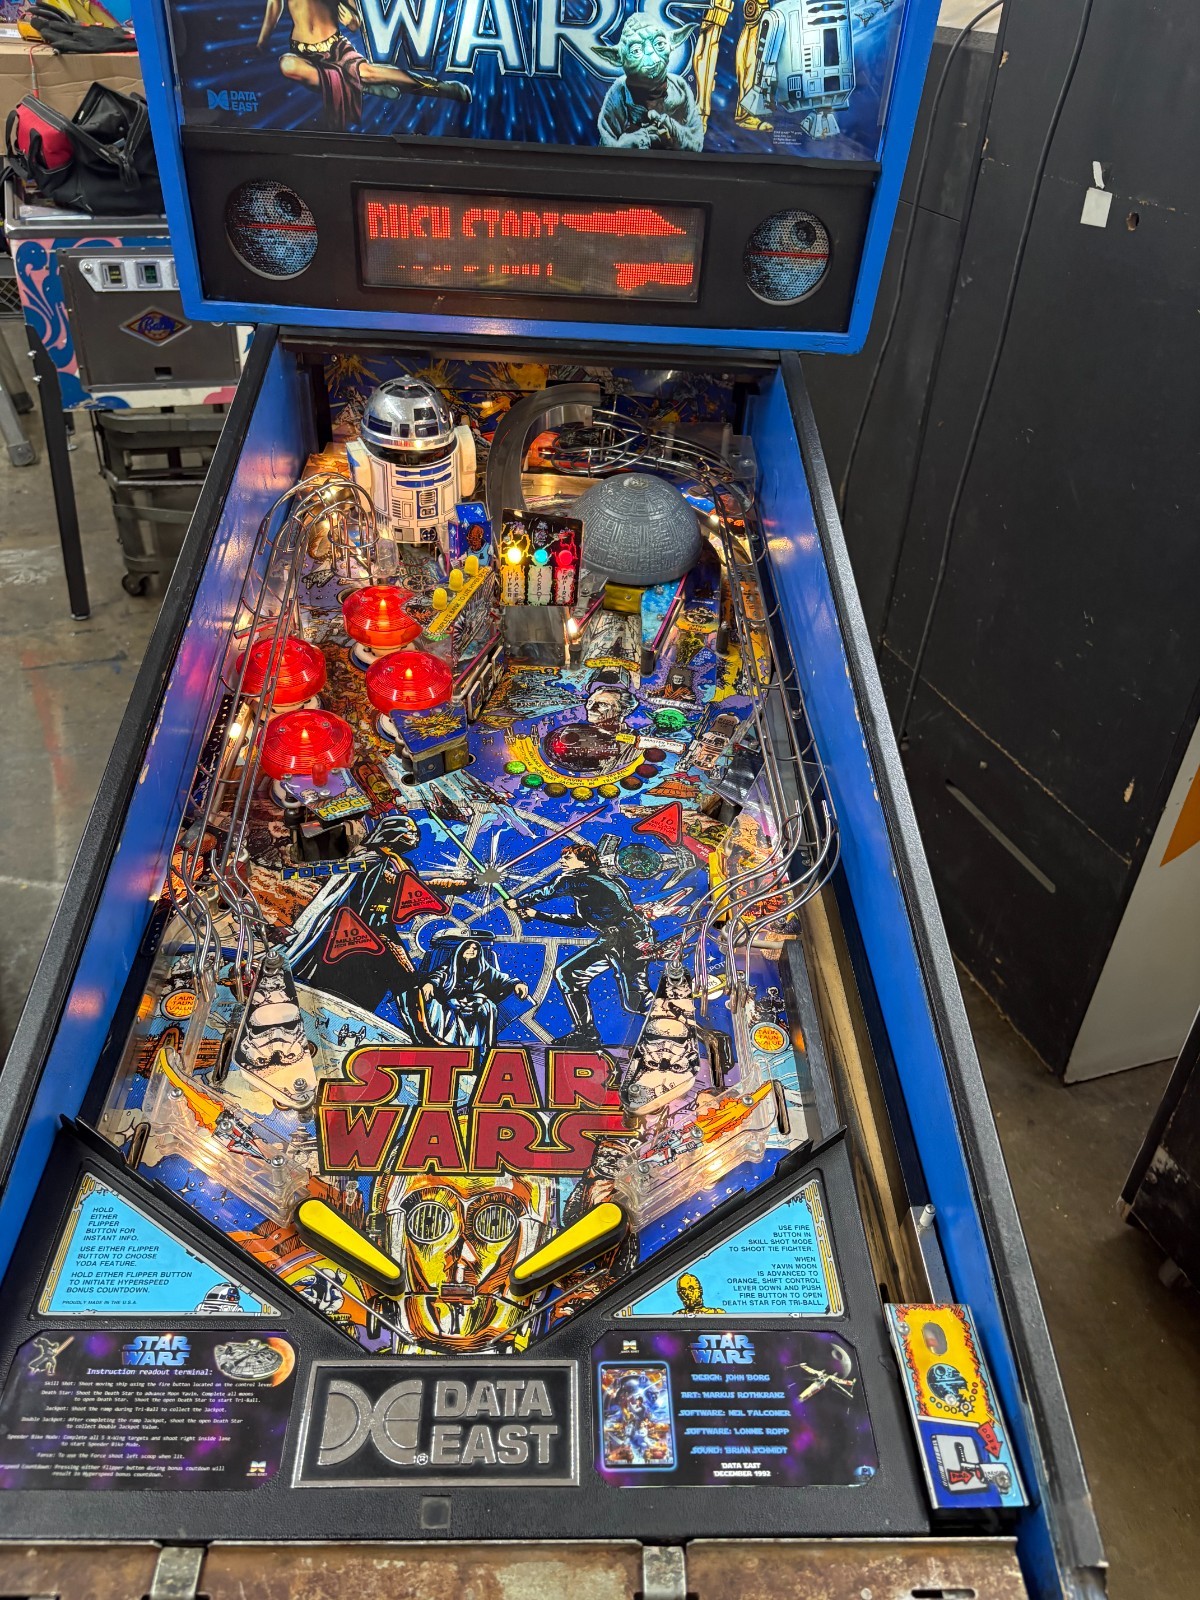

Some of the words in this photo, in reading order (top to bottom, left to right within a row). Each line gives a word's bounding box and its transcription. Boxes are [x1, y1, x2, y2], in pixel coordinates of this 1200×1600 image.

[230, 90, 257, 102] DATA
[231, 102, 259, 112] EAST
[318, 796, 368, 818] FORCE
[660, 816, 674, 826] 10
[282, 861, 366, 880] FORCE
[401, 896, 432, 906] MILLION
[408, 890, 423, 899] 10
[336, 934, 368, 944] MILLION
[343, 928, 359, 938] 10
[321, 1047, 624, 1109] STAR
[319, 1106, 641, 1174] WARS
[122, 1336, 192, 1350] STAR
[690, 1334, 755, 1349] STAR
[122, 1351, 190, 1365] WARS
[690, 1350, 756, 1364] WARS
[434, 1380, 553, 1418] DATA
[430, 1424, 558, 1465] EAST
[690, 1446, 722, 1454] SOUND:
[724, 1446, 750, 1454] BRIAN
[752, 1446, 788, 1454] SCHMIDT
